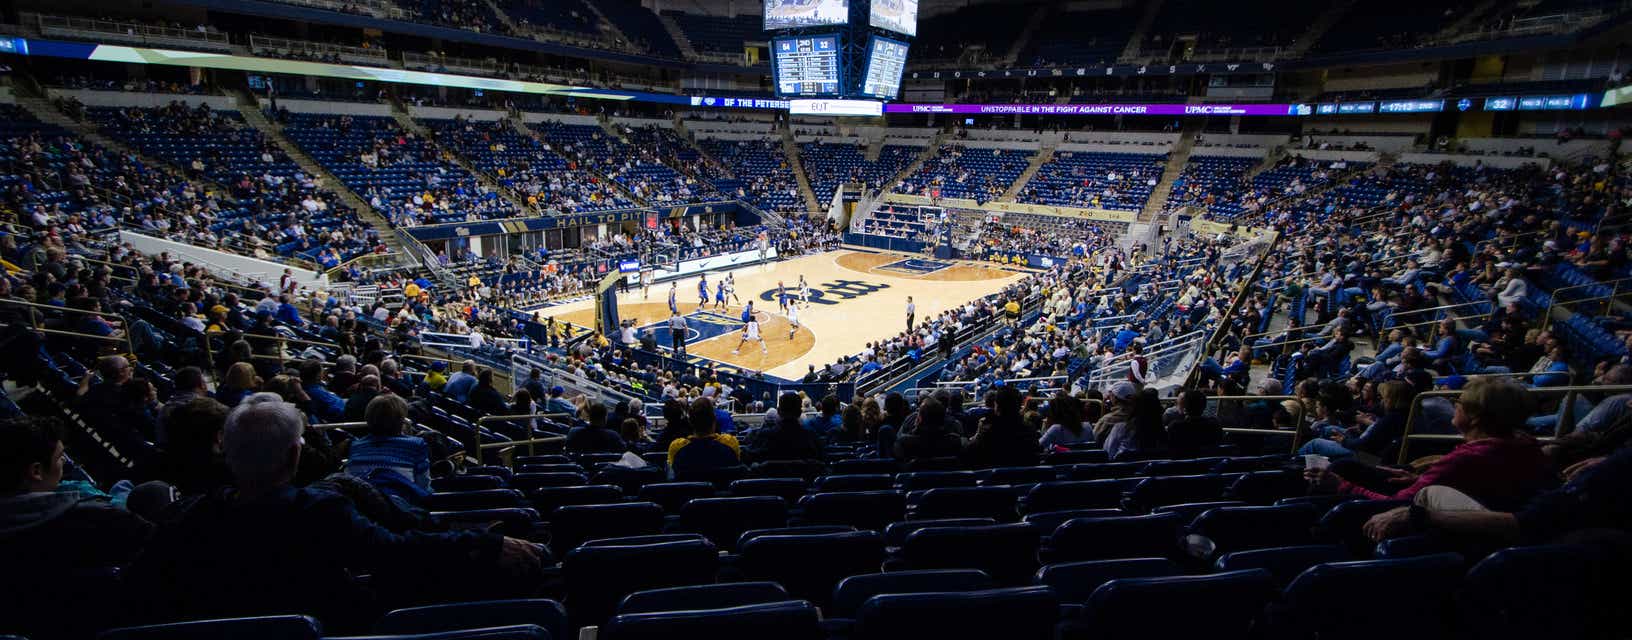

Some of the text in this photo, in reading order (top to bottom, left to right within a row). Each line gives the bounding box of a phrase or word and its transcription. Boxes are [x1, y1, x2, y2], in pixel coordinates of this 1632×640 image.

[724, 98, 790, 109] OF THE PETERSE
[1493, 99, 1507, 109] 32
[980, 105, 1031, 113] UNSTOPPABLE
[1032, 105, 1040, 113] IN
[1041, 105, 1055, 113] THE
[1114, 106, 1148, 114] CANCER
[1185, 105, 1212, 114] UPMC
[557, 212, 641, 229] HAIL TO PIT
